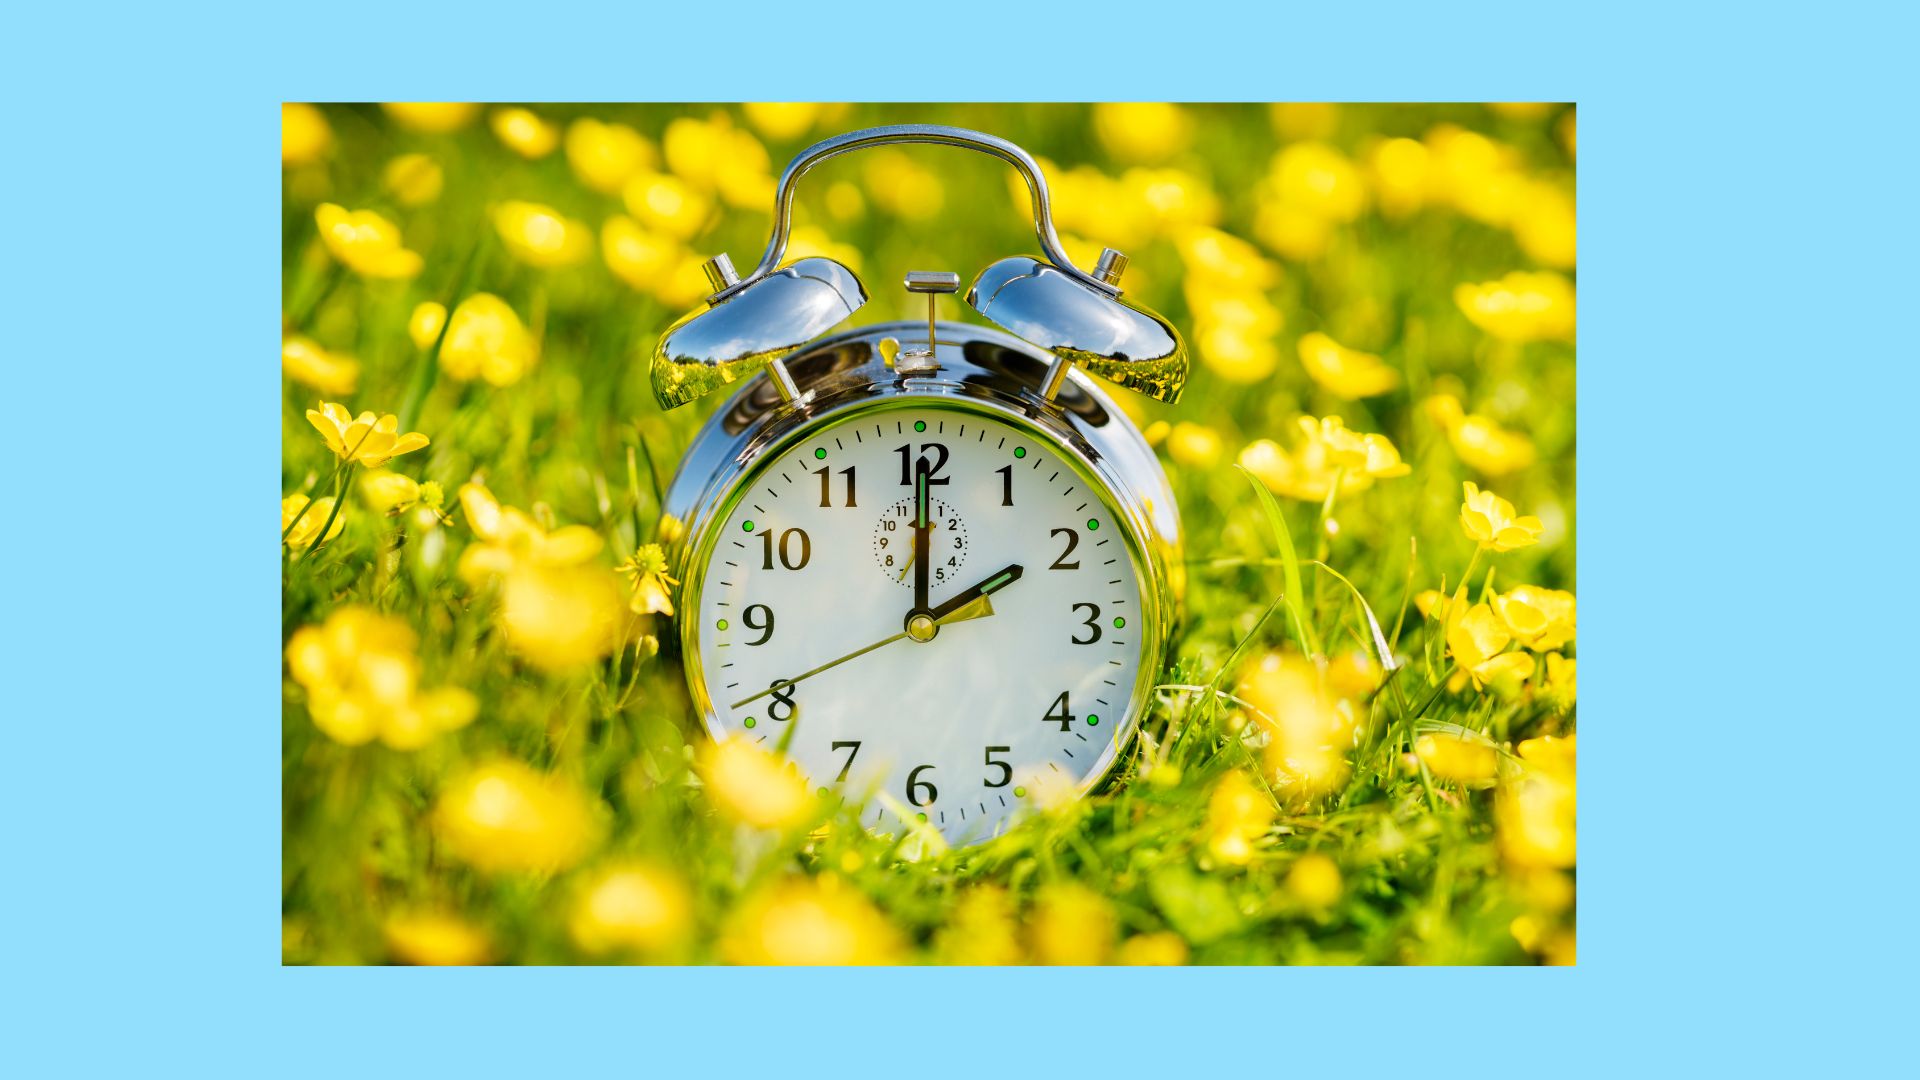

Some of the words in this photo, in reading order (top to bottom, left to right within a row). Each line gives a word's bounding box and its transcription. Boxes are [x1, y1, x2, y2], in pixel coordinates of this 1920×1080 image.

[893, 443, 951, 486] 12
[994, 464, 1015, 506] 1
[812, 465, 858, 507] 11
[882, 520, 896, 532] 10
[896, 505, 907, 517] 11
[938, 505, 943, 517] 1
[948, 518, 957, 531] 2
[755, 527, 811, 571] 10
[879, 537, 889, 549] 9
[885, 554, 894, 567] 8
[947, 556, 957, 567] 4
[953, 537, 963, 549] 3
[1048, 527, 1081, 571] 2
[935, 567, 945, 580] 5
[742, 603, 775, 647] 9
[1070, 602, 1103, 646] 3
[767, 678, 797, 721] 8
[1041, 690, 1076, 732] 4
[831, 740, 862, 783] 7
[983, 745, 1014, 788] 5
[905, 763, 938, 807] 6
